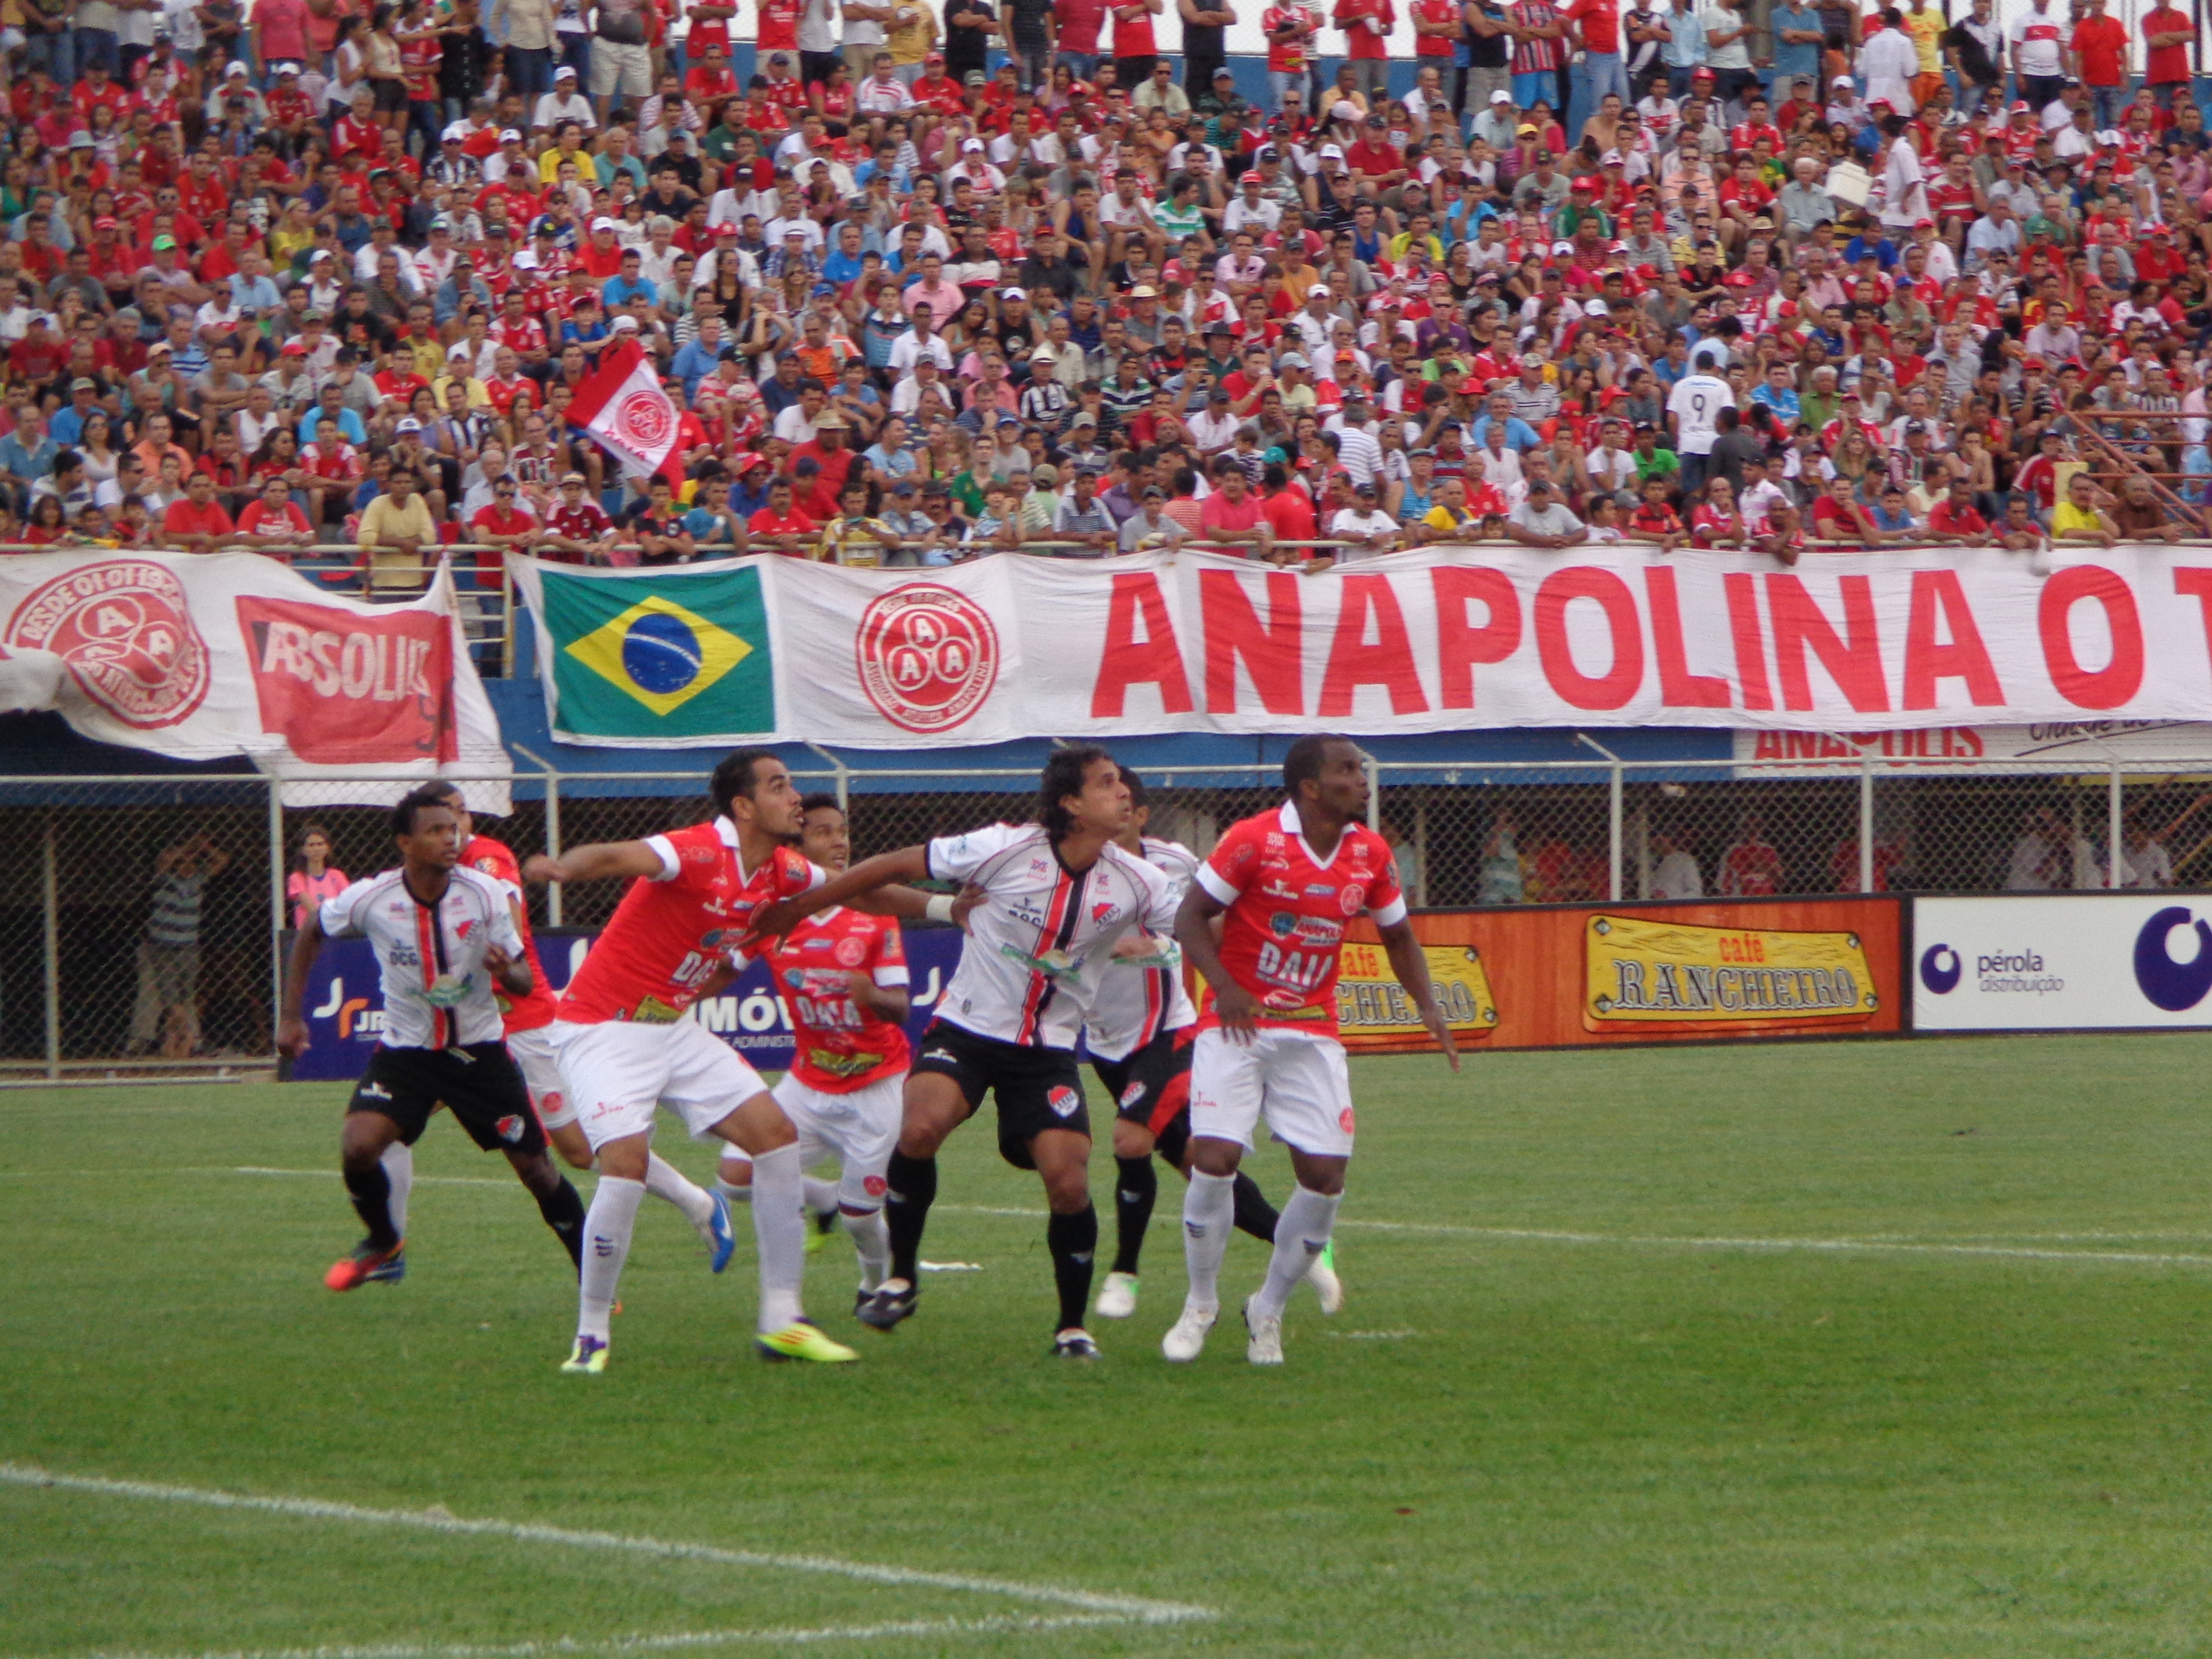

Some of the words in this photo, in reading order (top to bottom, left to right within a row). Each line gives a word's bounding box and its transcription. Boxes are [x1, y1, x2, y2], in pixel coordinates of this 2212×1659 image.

[1692, 394, 1706, 422] 9
[1091, 565, 2007, 718] ANAPOLINA
[2037, 564, 2145, 710] O
[1339, 946, 1380, 977] afé
[1977, 949, 2044, 978] pérola
[1611, 959, 1859, 1011] RANCHEIRO
